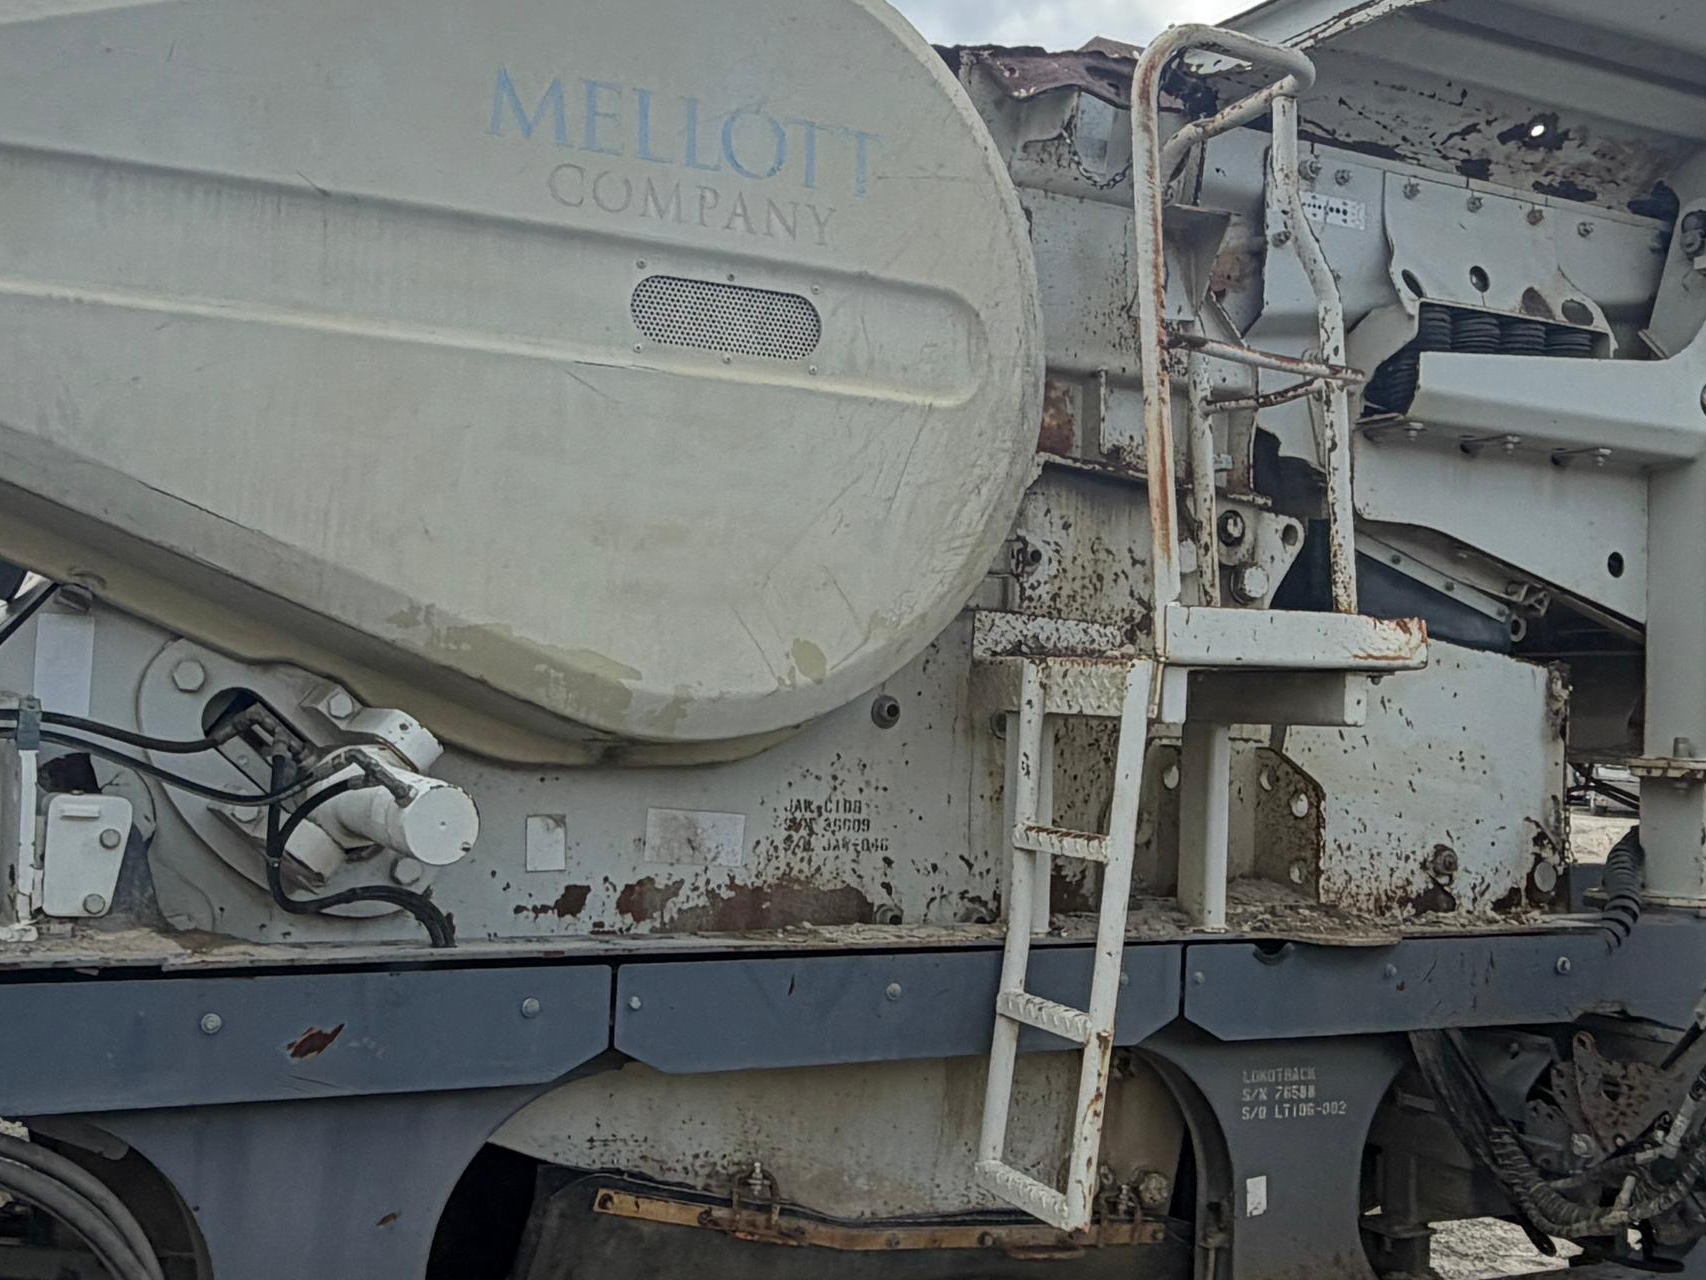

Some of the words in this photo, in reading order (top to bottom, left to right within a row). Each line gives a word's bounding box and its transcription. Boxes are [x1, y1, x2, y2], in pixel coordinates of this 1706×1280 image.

[484, 63, 883, 201] MELLOTT
[546, 161, 838, 247] COMPANY
[1242, 1066, 1317, 1084] LOKOTRACK
